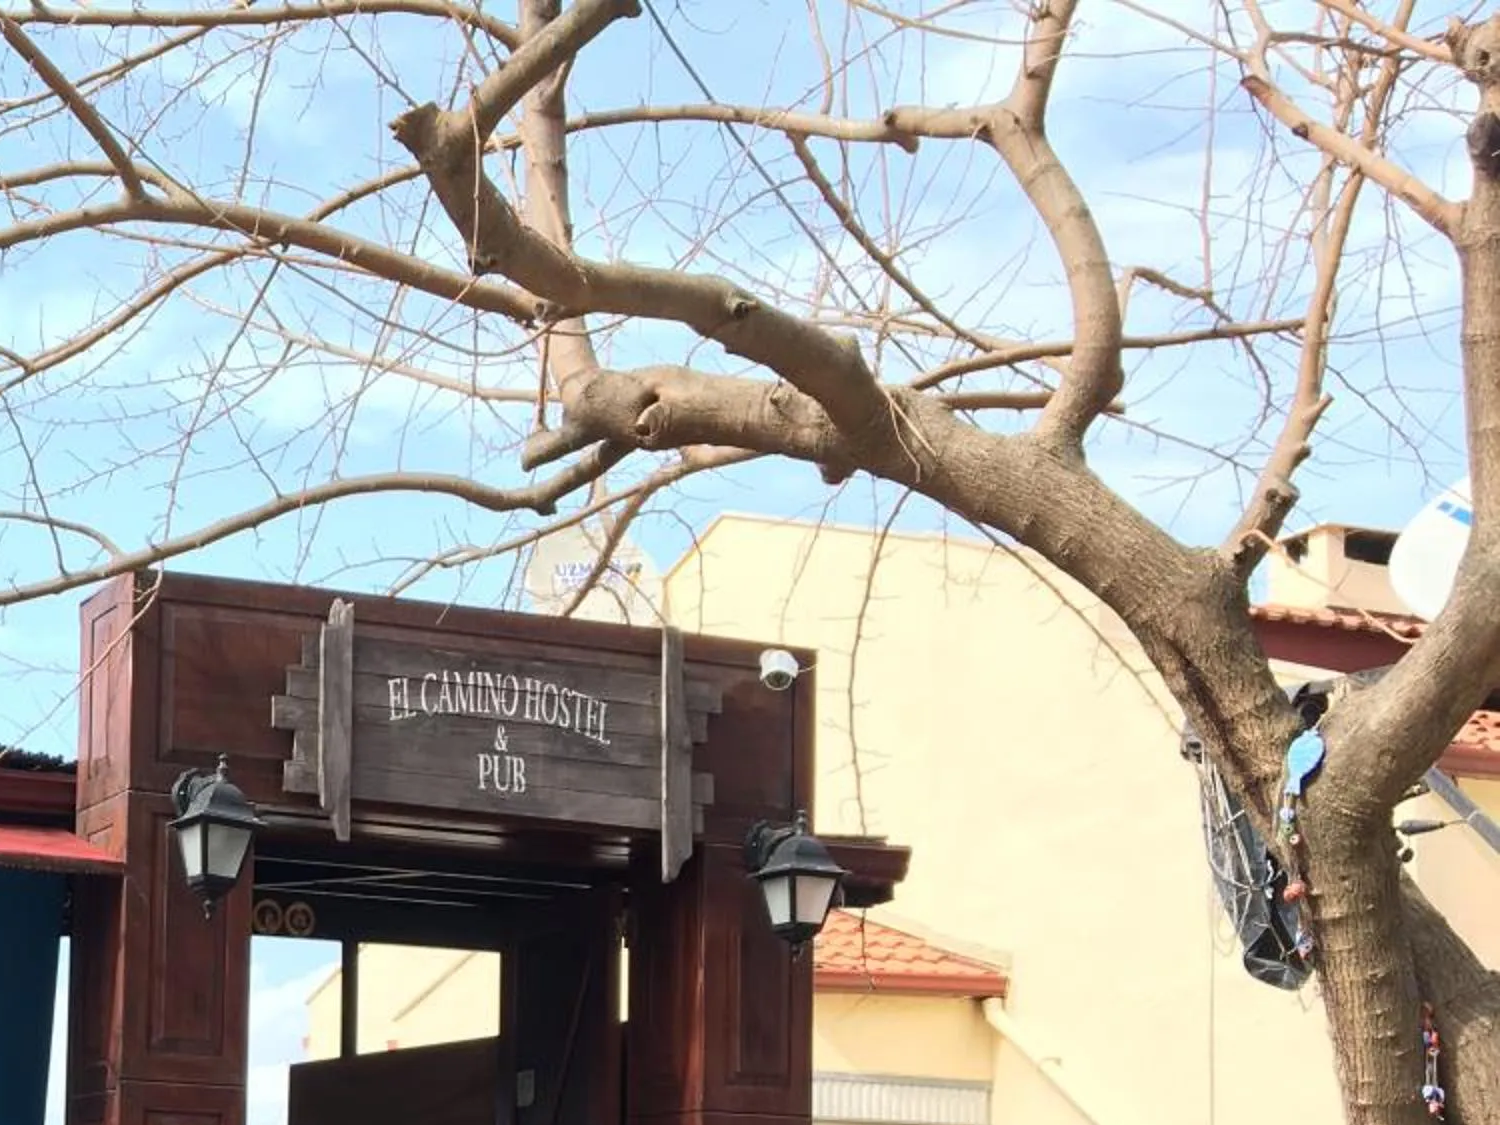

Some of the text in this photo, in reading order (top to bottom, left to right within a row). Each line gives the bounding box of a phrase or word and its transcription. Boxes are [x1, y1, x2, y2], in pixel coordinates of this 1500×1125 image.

[388, 677, 416, 721] EL
[524, 676, 611, 745] HOSTEL
[494, 724, 508, 751] &
[477, 753, 526, 793] PUB
